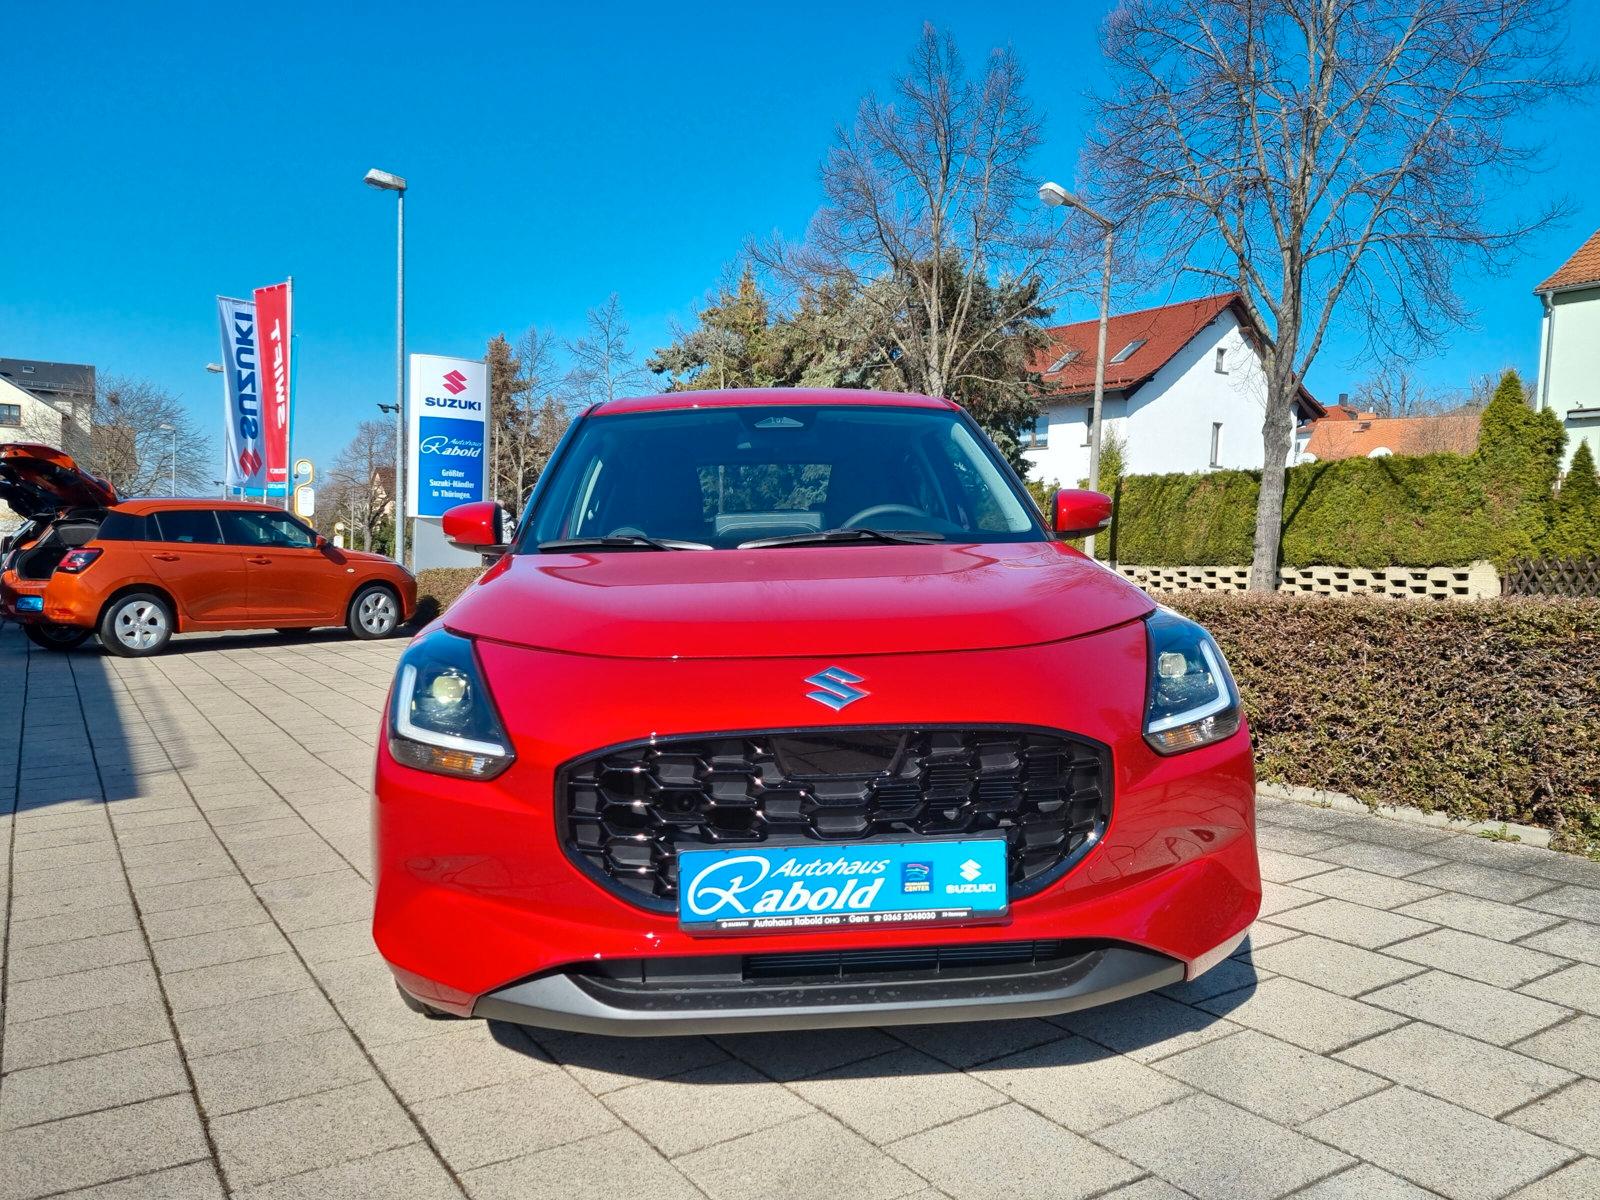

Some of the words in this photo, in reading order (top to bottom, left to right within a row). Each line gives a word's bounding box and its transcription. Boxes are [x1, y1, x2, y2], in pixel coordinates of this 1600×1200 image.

[425, 396, 482, 411] SUZUKI
[420, 435, 481, 458] Rabold
[449, 438, 483, 447] Autohaus
[441, 469, 465, 478] Größter
[429, 479, 475, 489] Suzuki-Händler
[770, 857, 891, 878] Autohaus
[687, 855, 886, 916] Rabold
[946, 883, 997, 894] SUZUKI
[753, 918, 793, 928] Autohaus
[794, 916, 823, 926] Rabold
[849, 914, 869, 923] Gera
[883, 912, 902, 922] 0365
